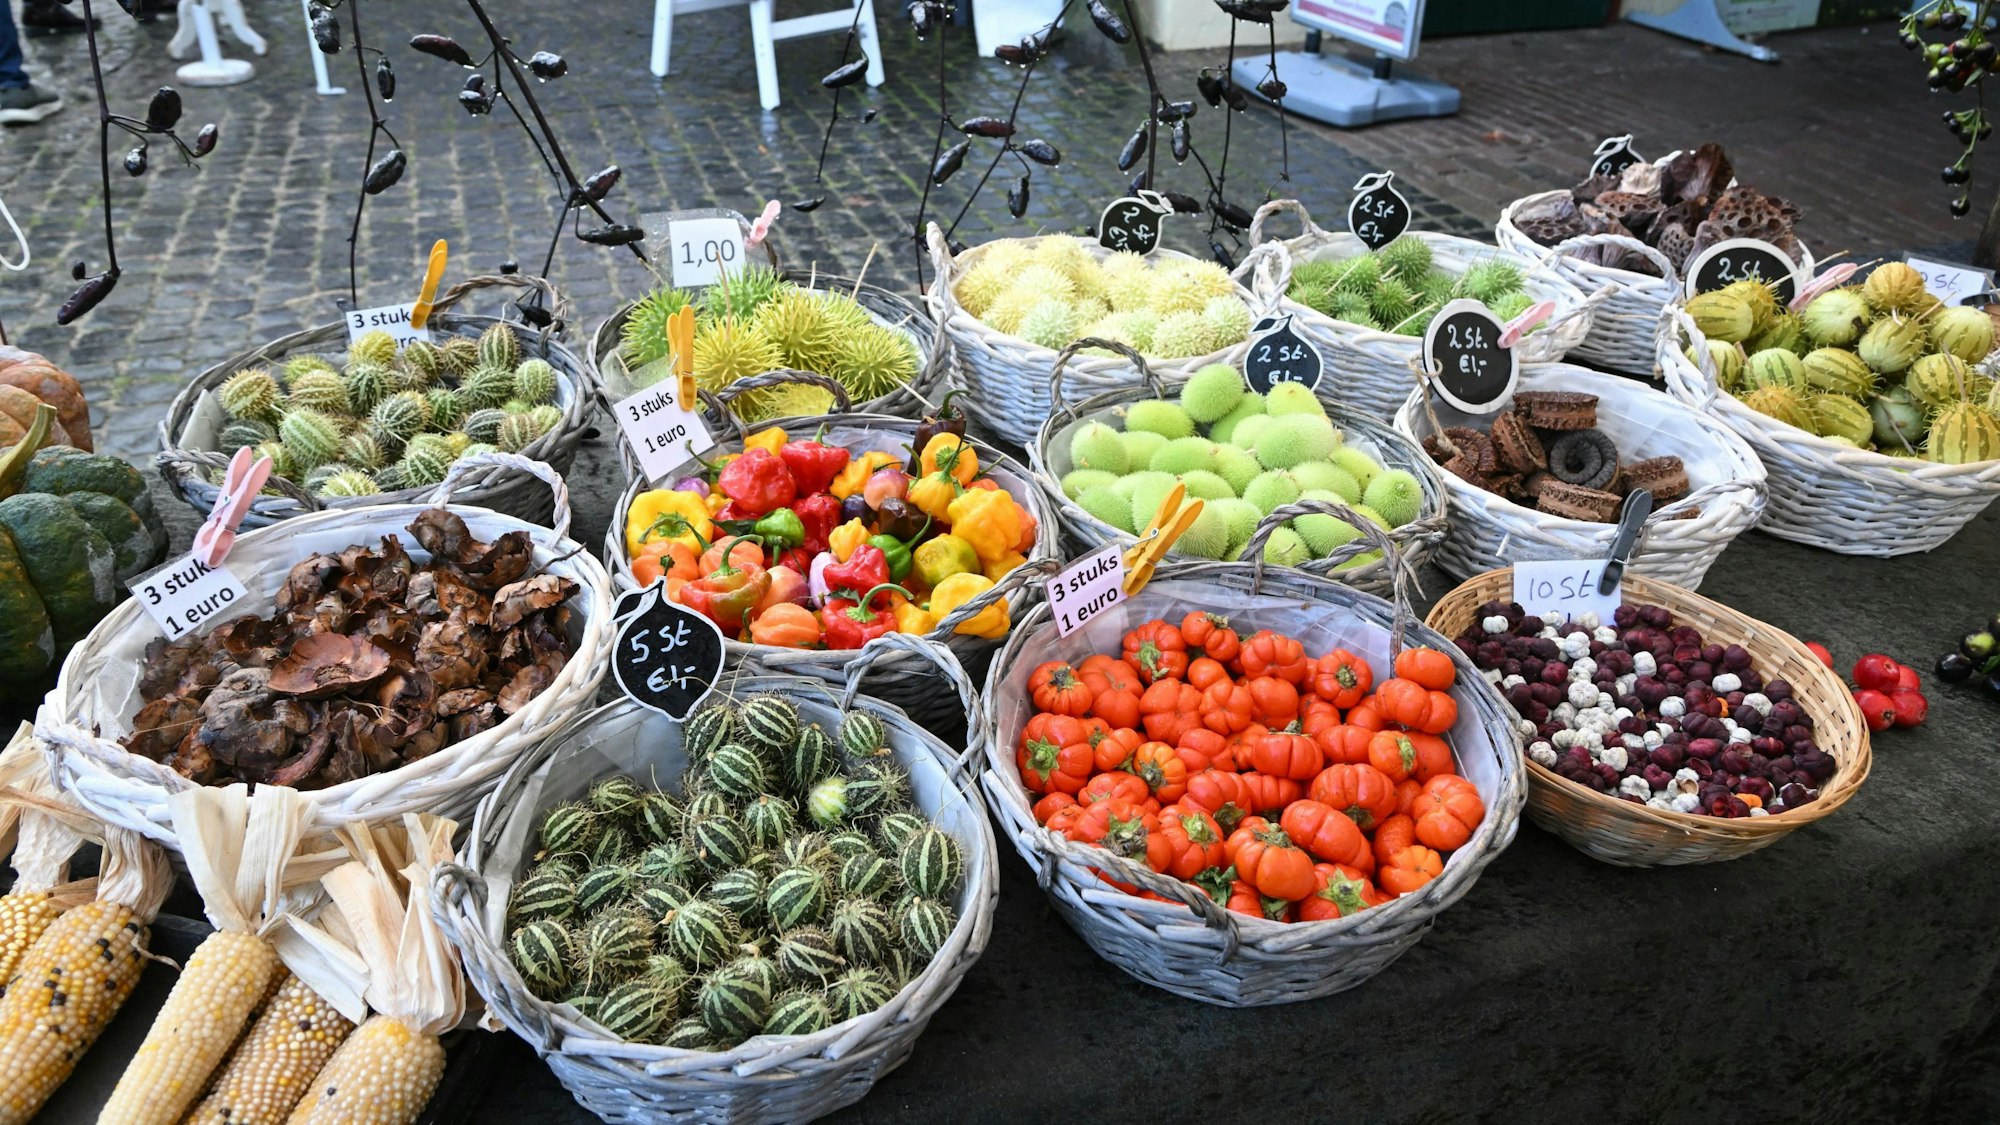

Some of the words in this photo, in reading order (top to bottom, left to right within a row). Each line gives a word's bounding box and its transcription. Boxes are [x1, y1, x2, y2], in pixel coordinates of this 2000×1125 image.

[1122, 206, 1140, 224] 2
[1359, 195, 1373, 212] 2
[681, 239, 735, 268] 1,00
[1717, 257, 1735, 281] 2
[353, 314, 365, 328] 3
[371, 308, 412, 326] stuk
[1447, 323, 1462, 349] 2
[1464, 326, 1488, 349] St.
[1257, 344, 1271, 363] 2
[1279, 344, 1307, 361] St.
[1459, 353, 1487, 377] €1,-
[629, 405, 640, 422] 3
[641, 392, 673, 416] stuks
[645, 437, 656, 453] 1
[656, 424, 686, 447] euro
[144, 585, 162, 606] 3
[164, 558, 215, 595] stuk
[1053, 583, 1065, 602] 3
[1070, 555, 1118, 592] stuks
[1529, 578, 1553, 601] 10
[1560, 569, 1594, 600] St
[166, 615, 184, 635] 1
[185, 587, 235, 623] euro
[1061, 613, 1074, 632] 1
[1077, 587, 1118, 621] euro
[630, 628, 650, 664] 5
[659, 620, 691, 652] St
